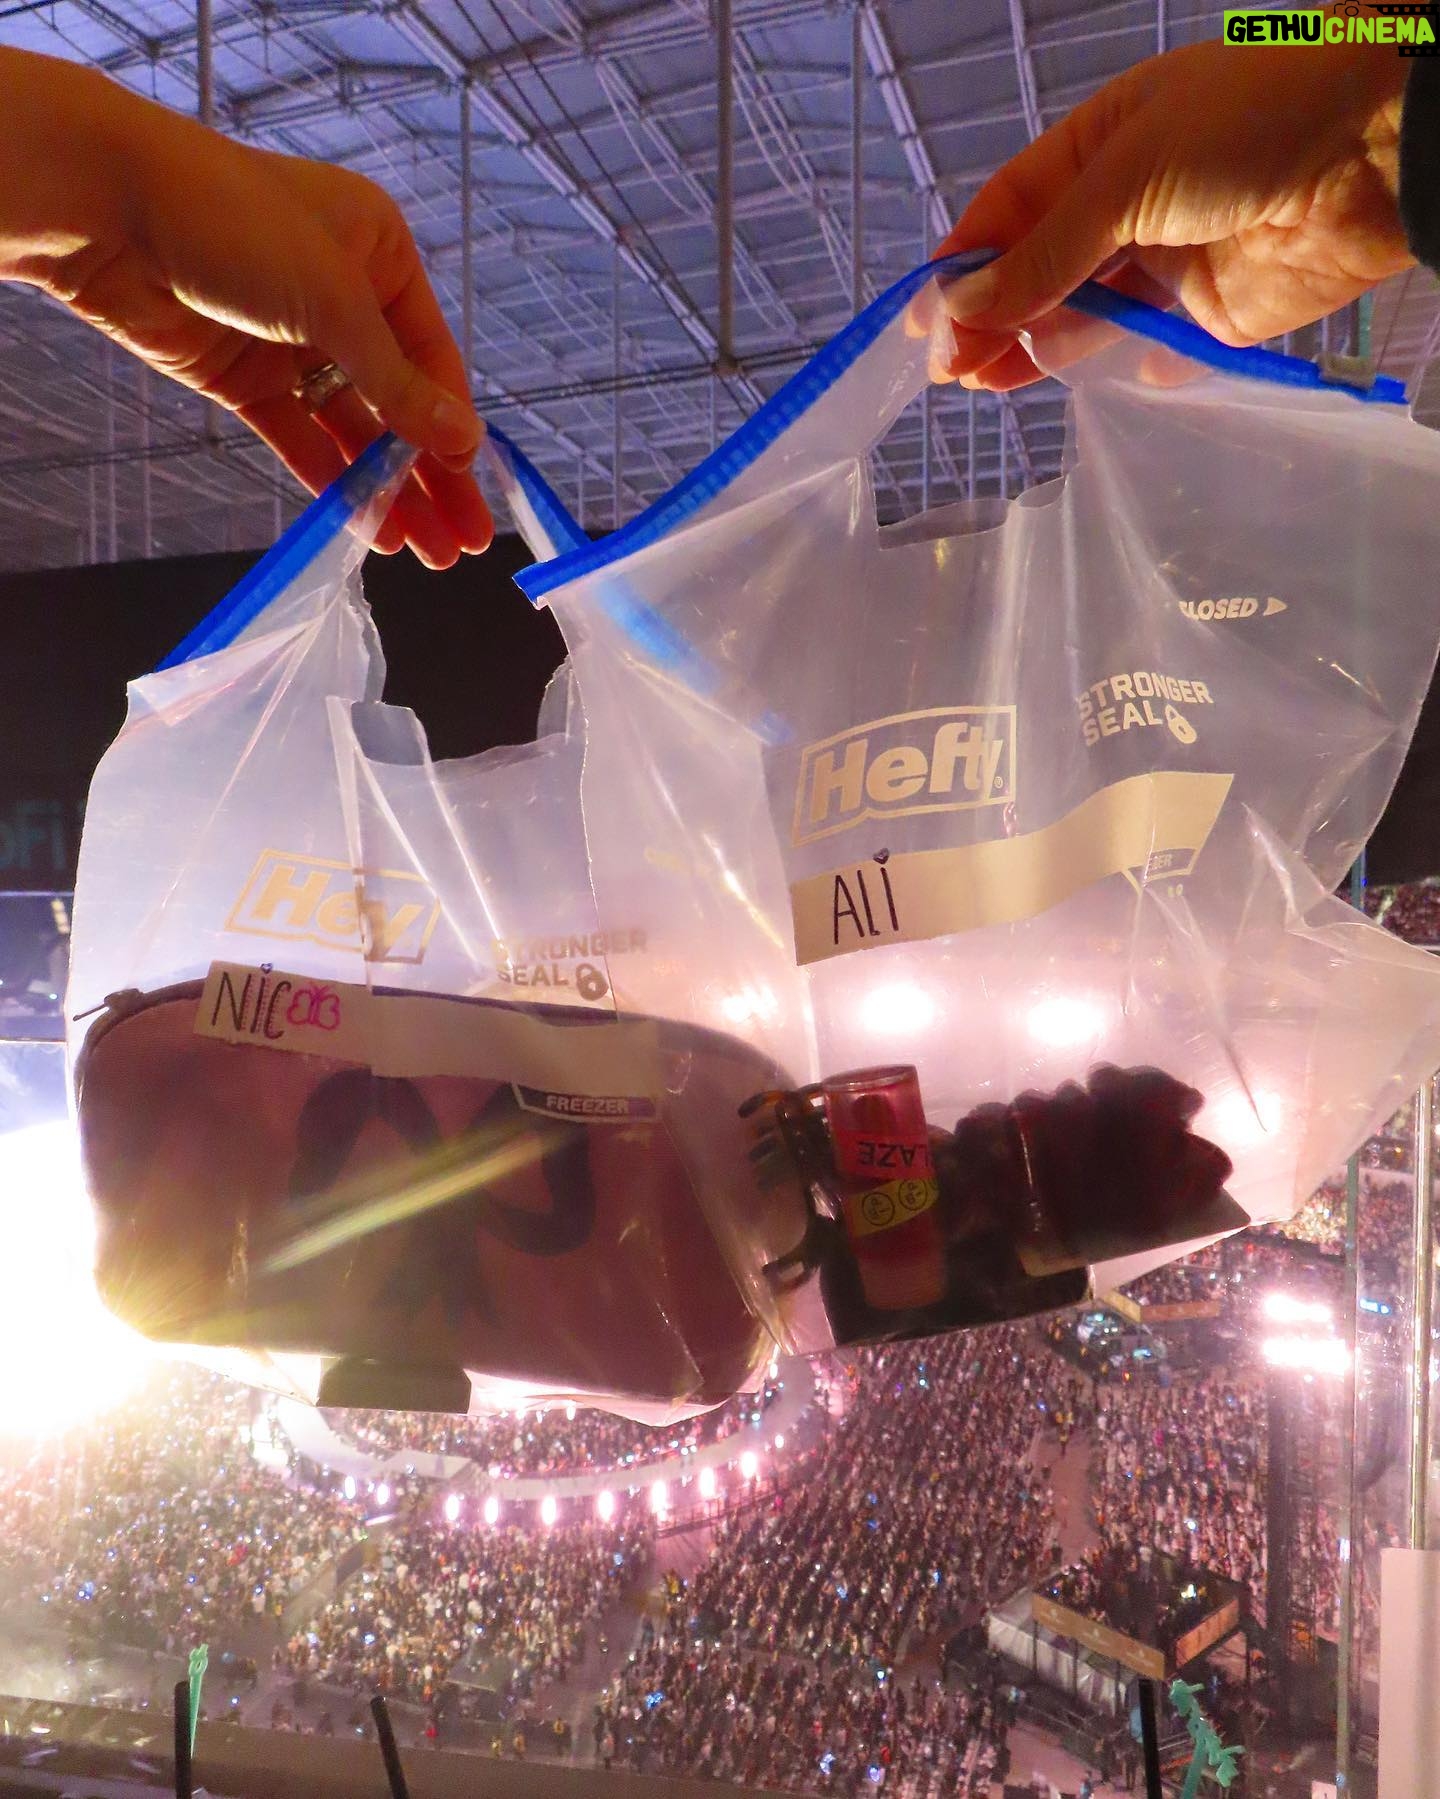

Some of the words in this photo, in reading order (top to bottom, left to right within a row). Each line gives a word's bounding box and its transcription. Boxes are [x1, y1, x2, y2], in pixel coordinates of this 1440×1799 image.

[1075, 671, 1215, 721] STRONGER
[1082, 699, 1164, 747] SEAL
[809, 721, 1004, 823] Hefty
[492, 928, 649, 961] STRONGER
[497, 962, 570, 988] SEAL
[545, 1094, 630, 1115] FREEZER
